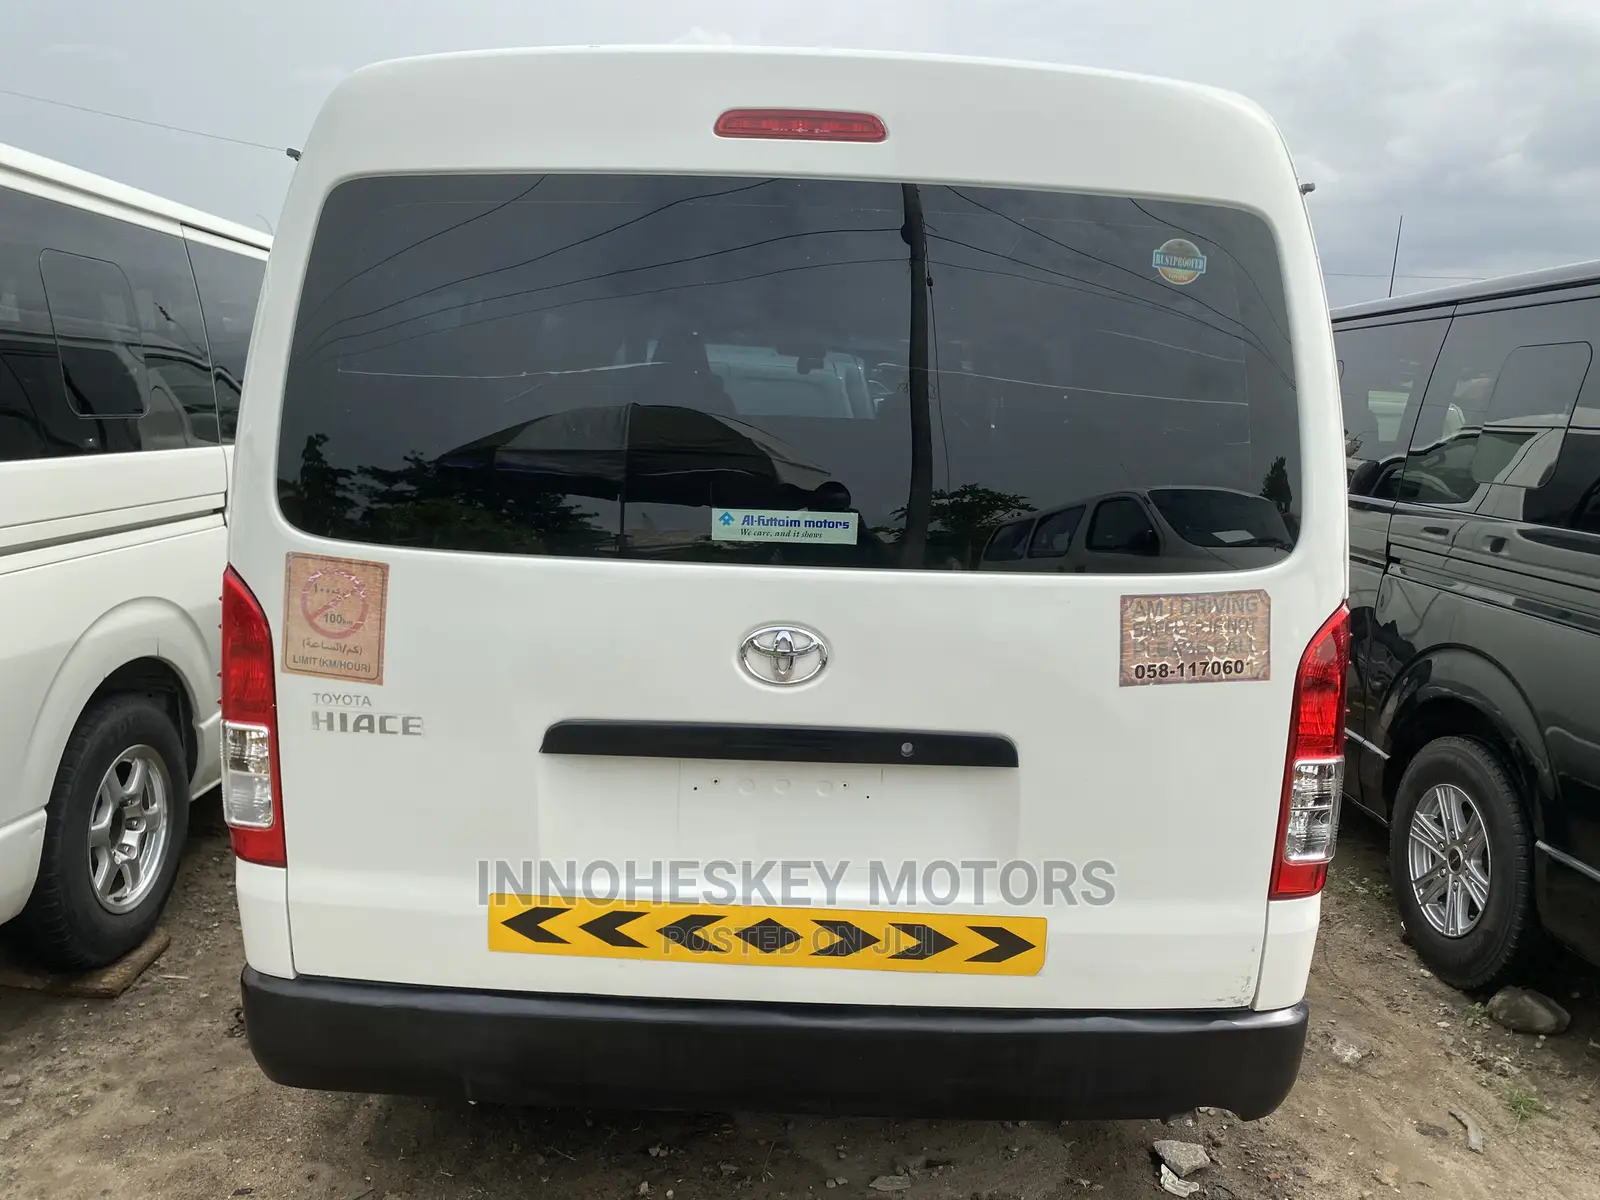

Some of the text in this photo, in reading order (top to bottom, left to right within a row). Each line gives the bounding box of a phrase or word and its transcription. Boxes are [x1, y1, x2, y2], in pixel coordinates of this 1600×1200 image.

[741, 515, 850, 529] Al-Futtaim motors
[740, 528, 823, 539] We care, and it shows
[292, 654, 371, 673] LIMIT (KM/HOUR)
[312, 692, 372, 707] TOYOTA
[311, 710, 424, 736] HIACE
